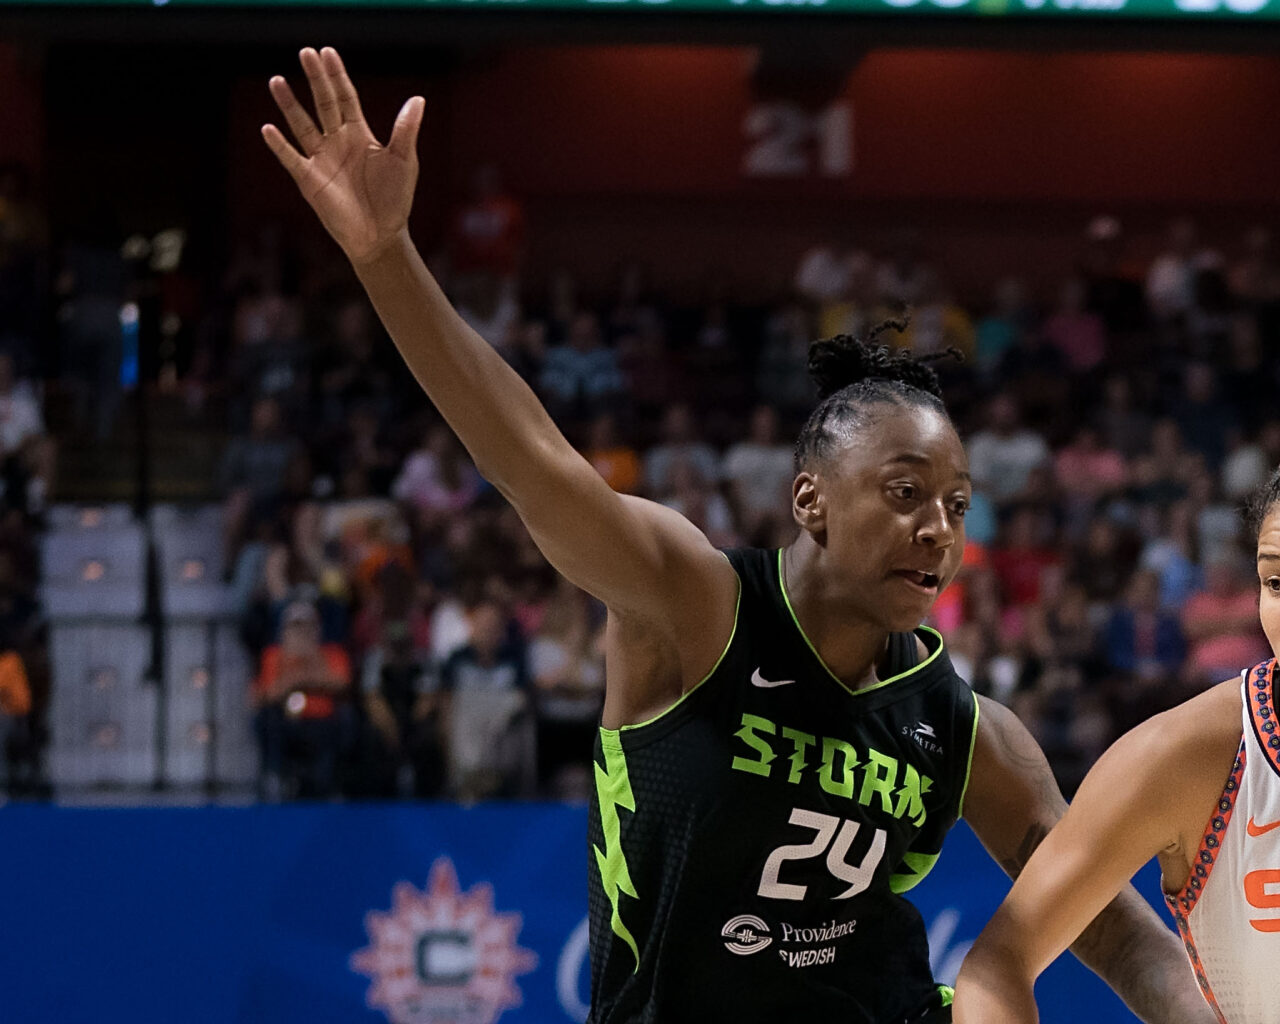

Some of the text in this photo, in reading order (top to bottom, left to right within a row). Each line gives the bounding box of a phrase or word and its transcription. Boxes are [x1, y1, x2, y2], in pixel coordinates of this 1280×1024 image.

[745, 103, 853, 176] 21
[731, 713, 934, 828] STORM
[757, 808, 887, 900] 24
[779, 946, 836, 968] SWEDISH
[781, 920, 857, 942] Providence
